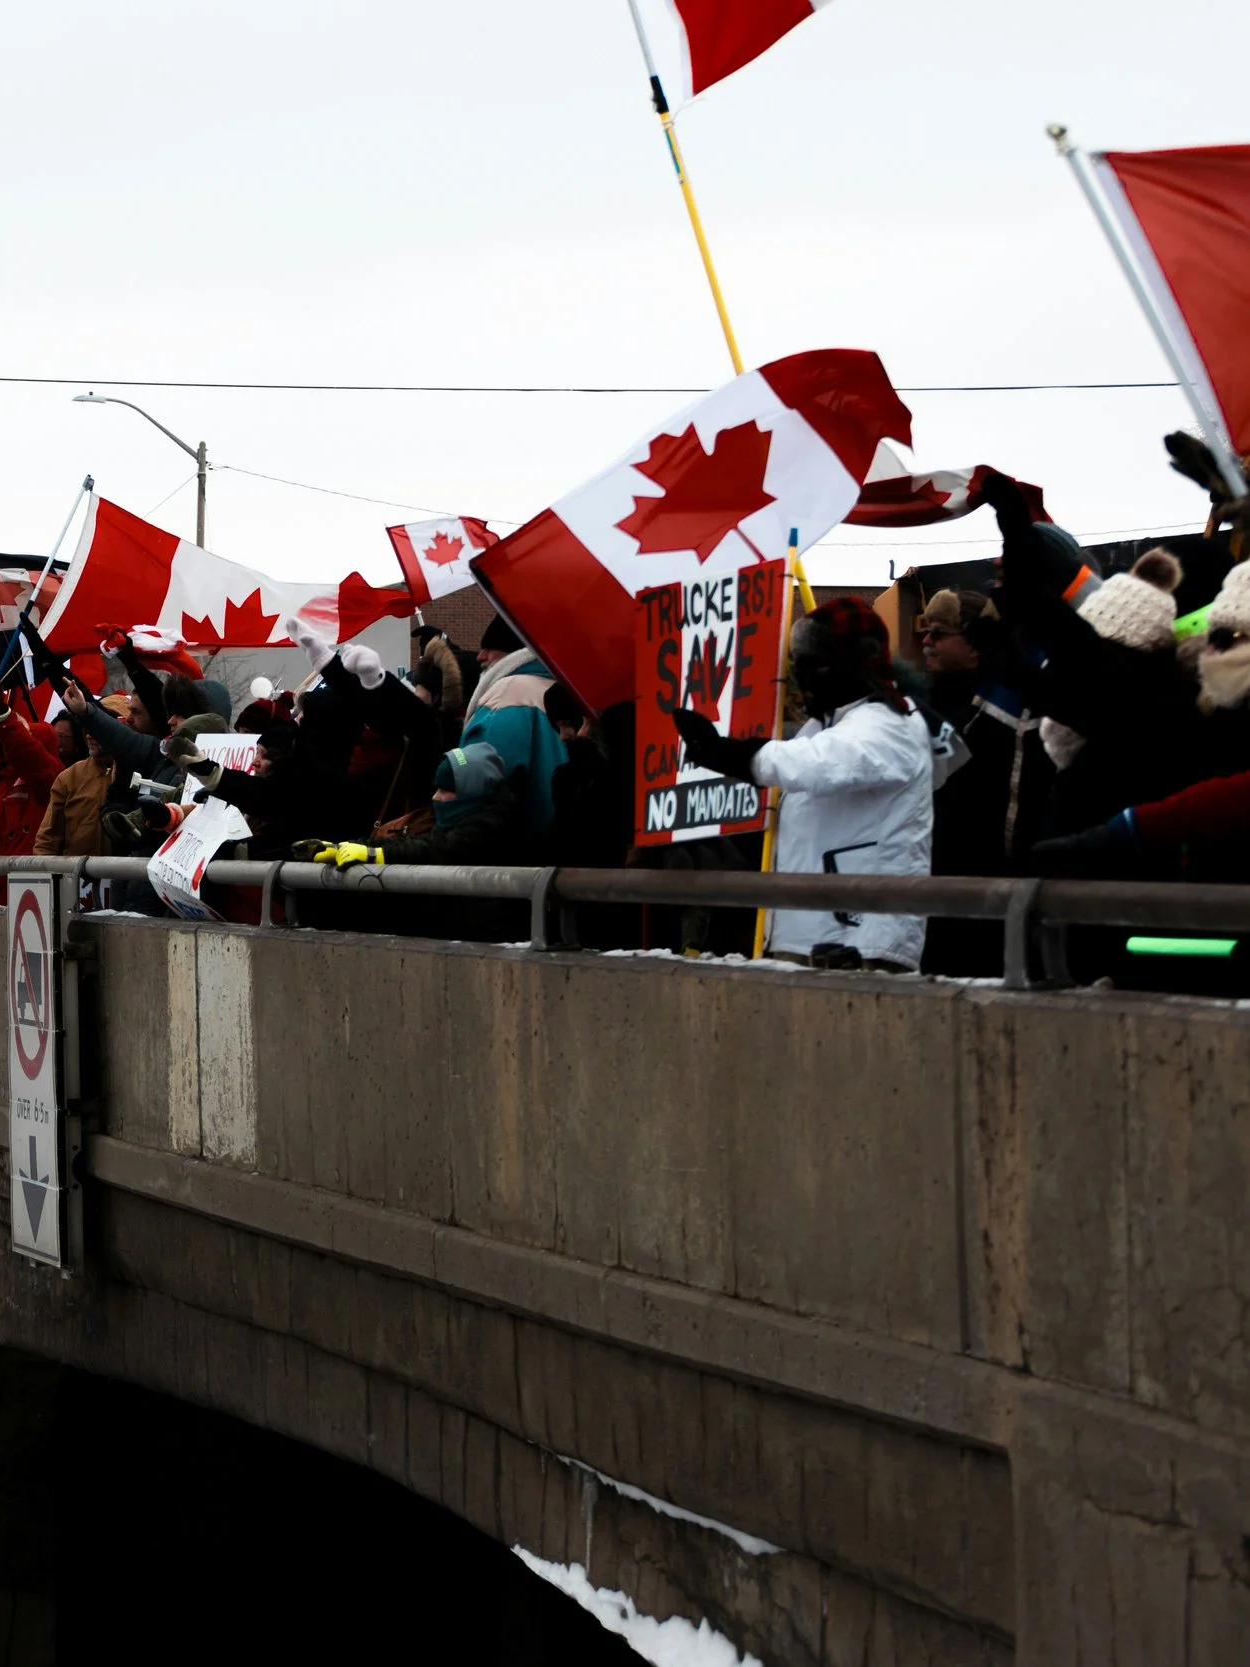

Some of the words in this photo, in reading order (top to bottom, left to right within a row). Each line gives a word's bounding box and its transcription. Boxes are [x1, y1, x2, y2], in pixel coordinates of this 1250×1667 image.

[640, 567, 775, 642] TRUCKERS!
[655, 622, 758, 715] SAVE
[217, 746, 256, 772] CANAD
[647, 790, 677, 832] NO
[686, 782, 759, 823] MANDATES
[17, 1097, 30, 1120] OVER
